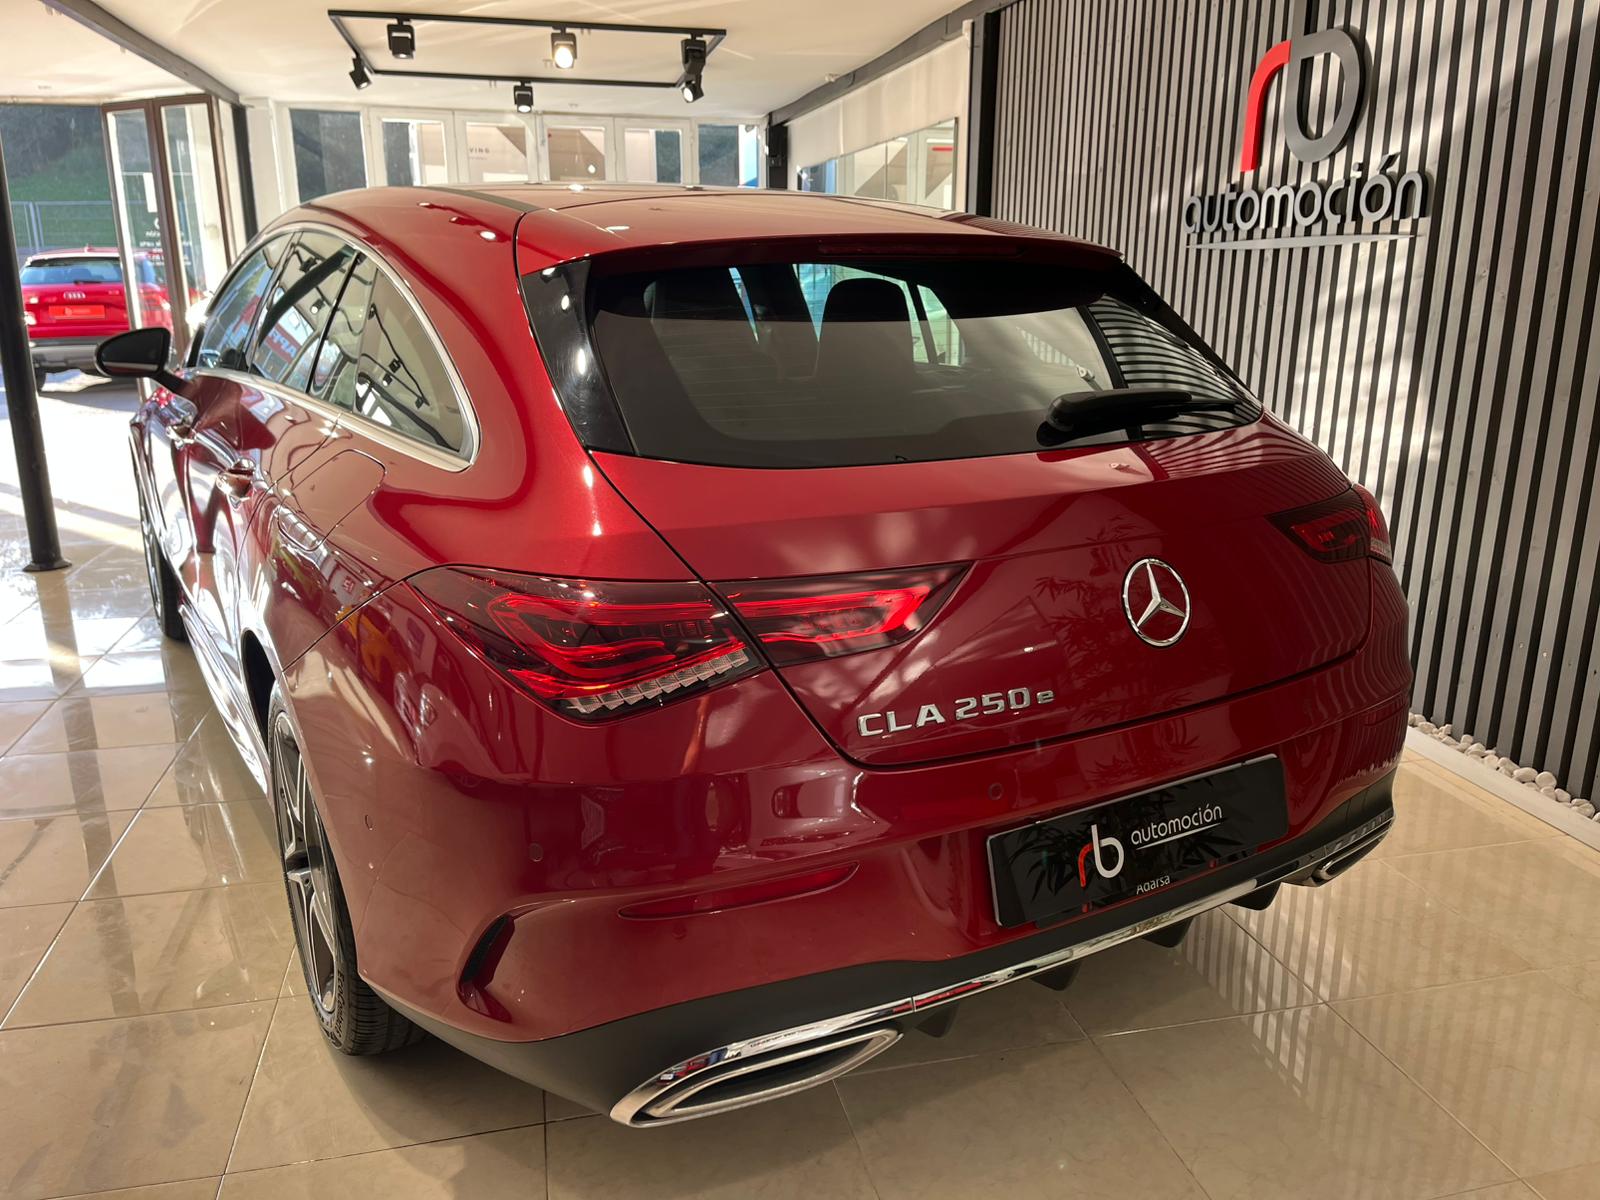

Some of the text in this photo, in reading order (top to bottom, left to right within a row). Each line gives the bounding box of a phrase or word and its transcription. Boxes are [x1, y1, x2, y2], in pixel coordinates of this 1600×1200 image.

[1185, 152, 1426, 234] automoción
[857, 703, 946, 737] CLA
[1131, 803, 1223, 845] automoción
